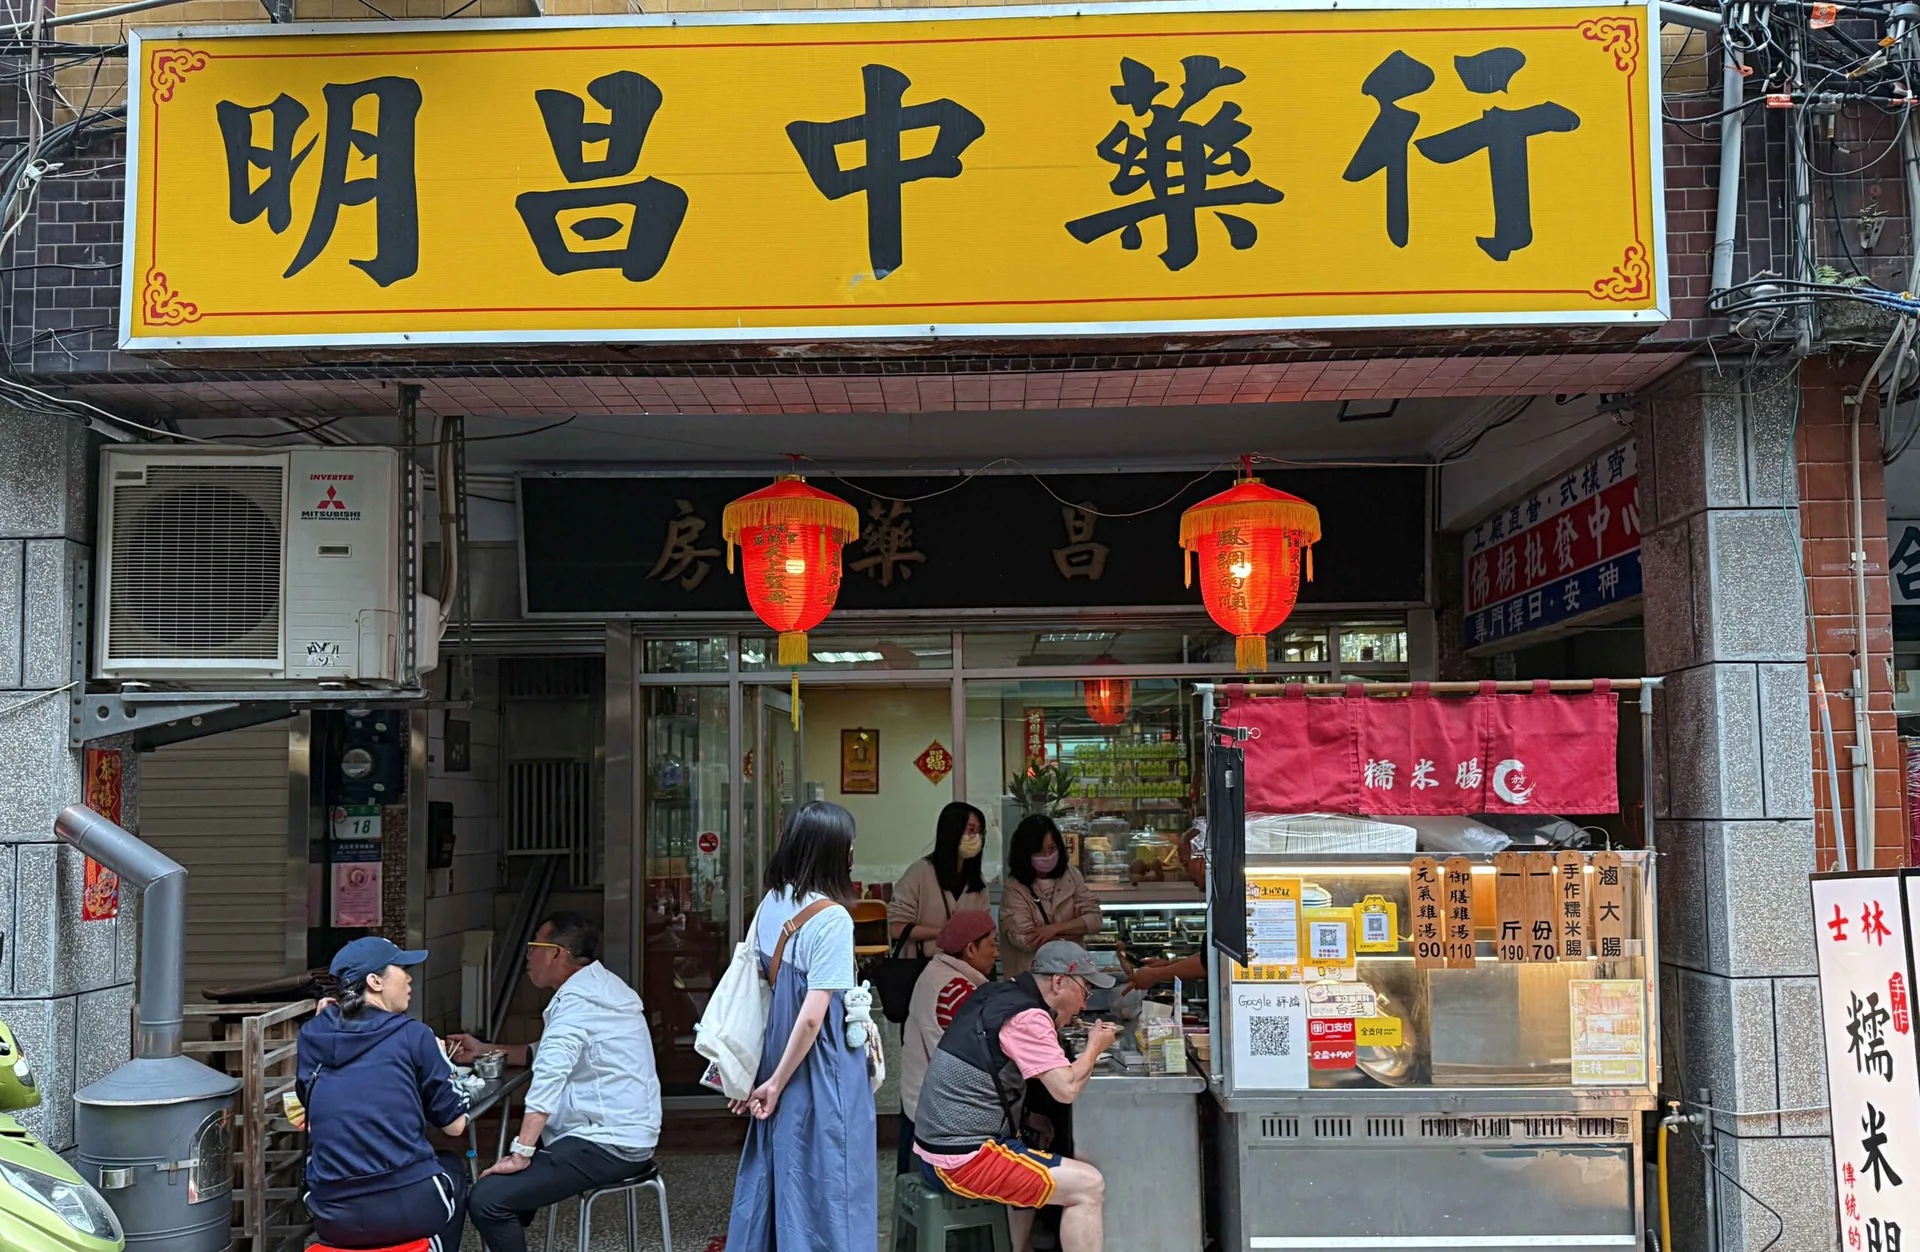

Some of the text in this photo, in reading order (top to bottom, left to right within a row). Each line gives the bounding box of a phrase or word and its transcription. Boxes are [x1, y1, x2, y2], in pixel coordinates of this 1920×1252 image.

[216, 46, 1581, 287] 明昌中藥行
[1363, 757, 1483, 791] 糯米腸
[352, 820, 371, 834] 18
[1415, 867, 1438, 939] 元氣雞湯
[1449, 870, 1471, 940] 御膳雞湯
[1563, 863, 1582, 956] 手作糯米腸
[1598, 865, 1622, 957] 滷大腸
[1827, 900, 1892, 946] 士林
[1419, 942, 1441, 958] 90
[1449, 943, 1472, 959] 110
[1500, 945, 1524, 960] 190
[1532, 945, 1554, 960] 70
[1238, 994, 1271, 1010] Google
[1891, 977, 1908, 1032] 手作
[1311, 1021, 1353, 1035] 街口支付
[1361, 1027, 1383, 1036] 全支付
[1842, 1161, 1861, 1251] 傳統的
